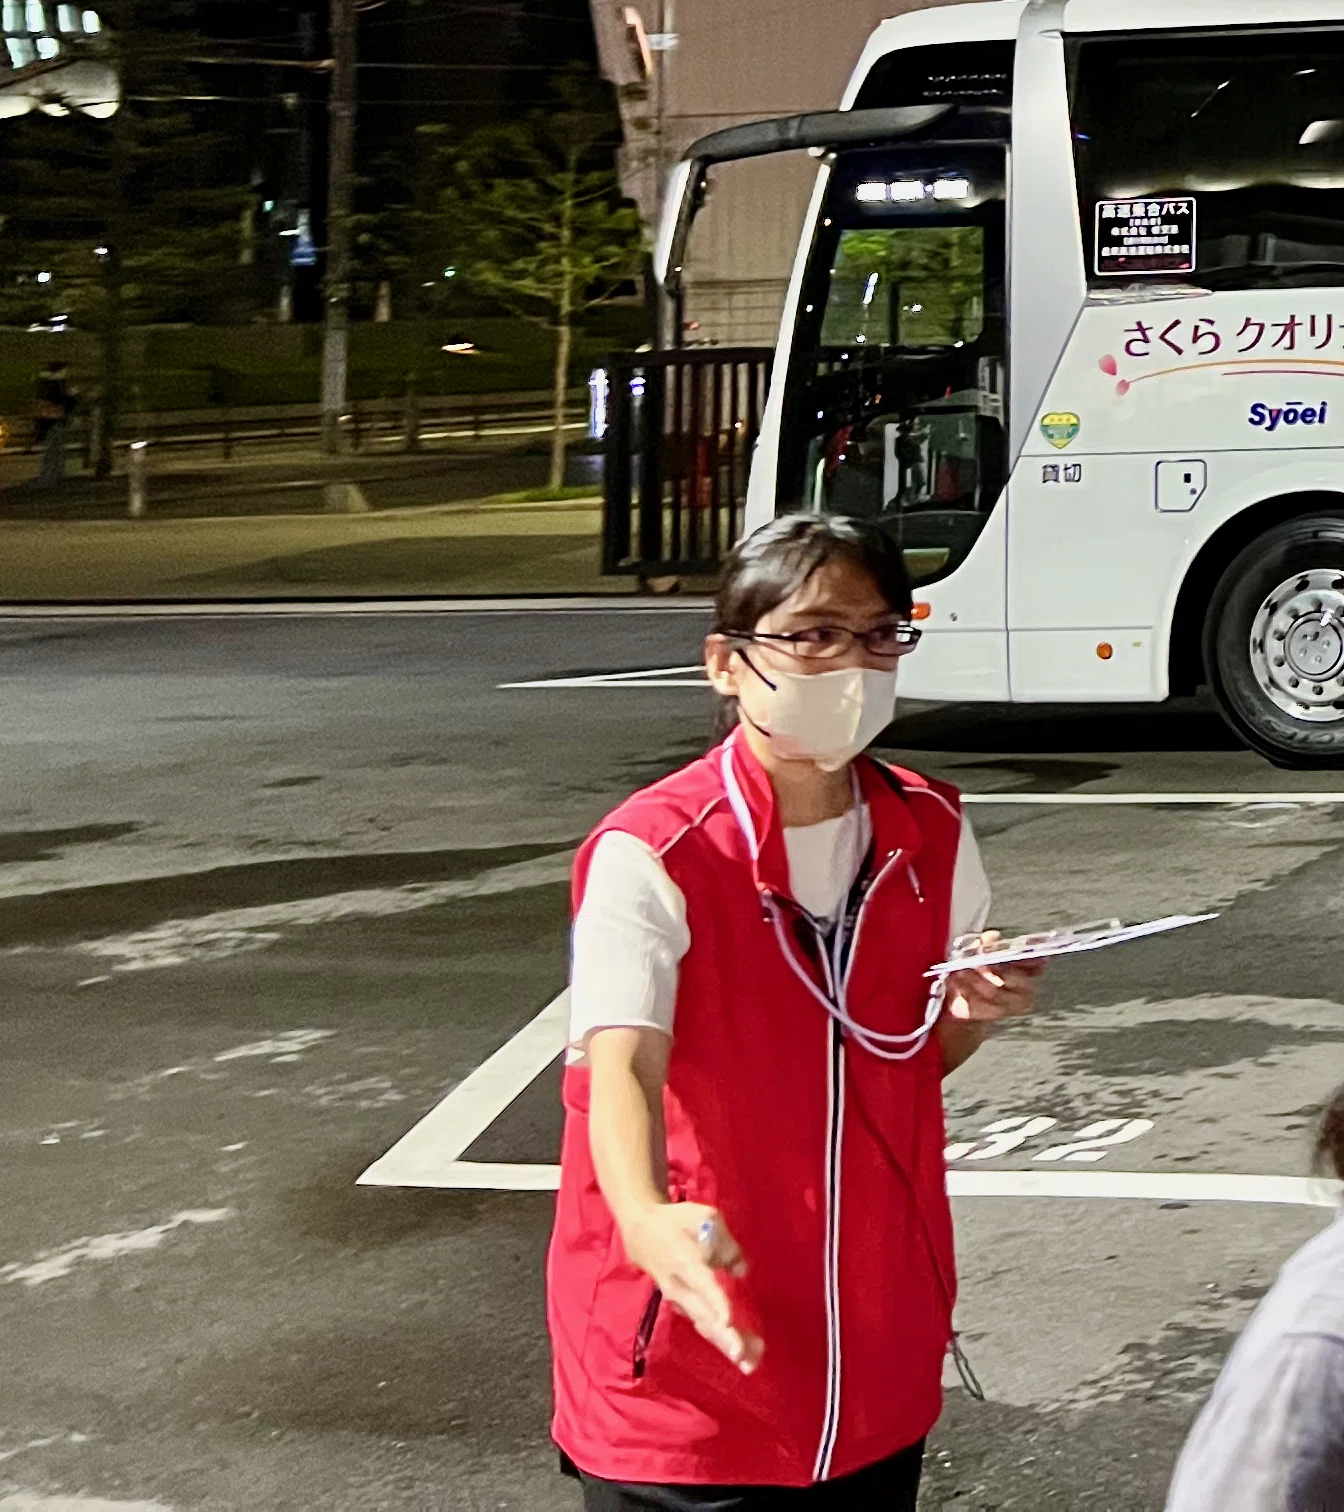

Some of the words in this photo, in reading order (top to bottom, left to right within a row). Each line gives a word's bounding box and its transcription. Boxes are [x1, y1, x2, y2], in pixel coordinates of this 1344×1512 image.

[1123, 317, 1222, 357] さくら
[1041, 462, 1082, 484] 貸切
[942, 1114, 1156, 1163] 32
